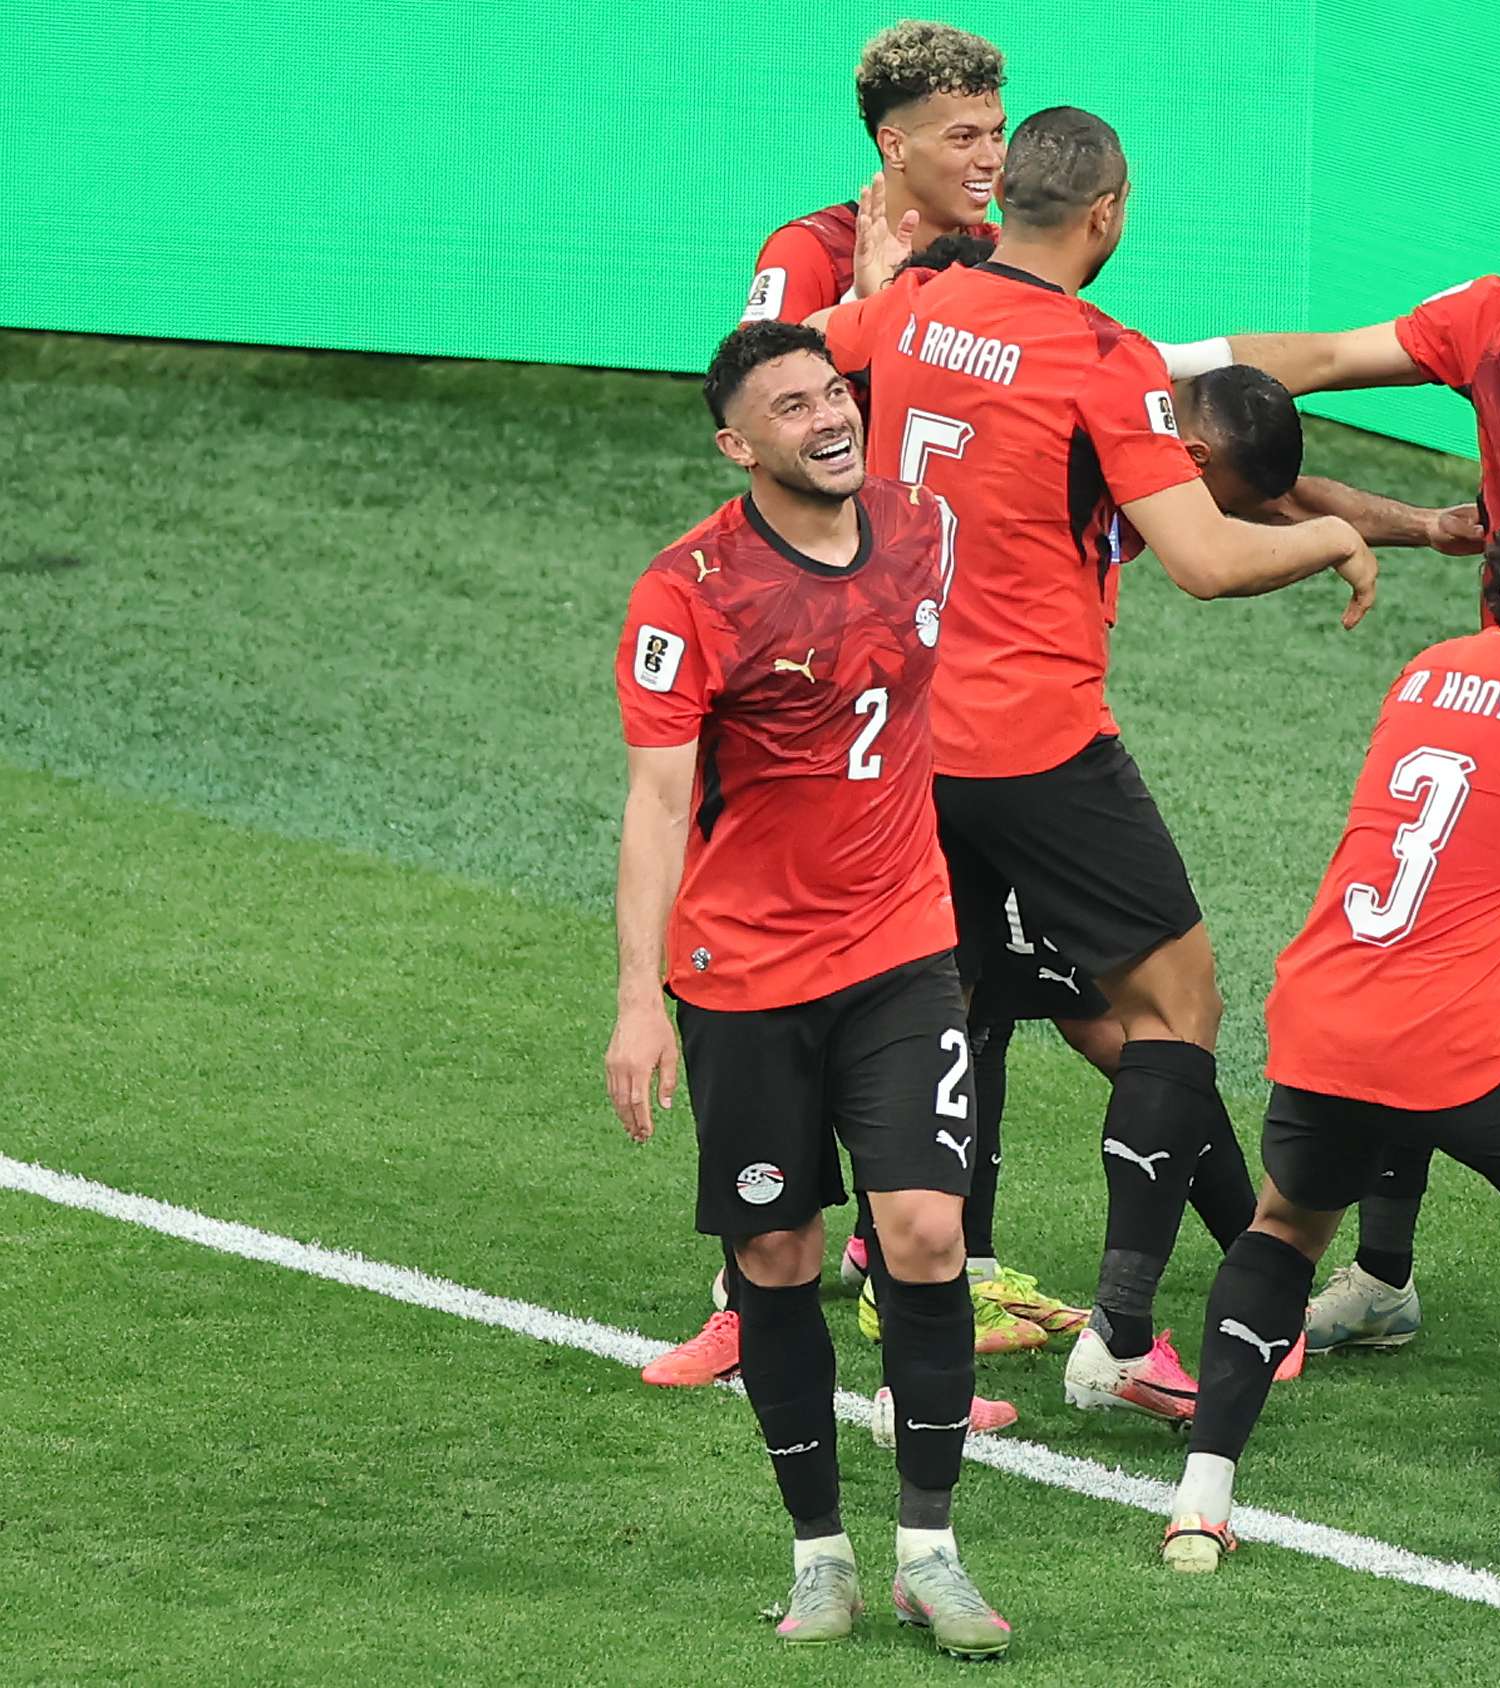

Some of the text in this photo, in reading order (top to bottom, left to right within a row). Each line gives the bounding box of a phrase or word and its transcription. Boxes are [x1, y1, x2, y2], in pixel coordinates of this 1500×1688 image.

[919, 321, 1021, 386] RABIAA
[1398, 670, 1423, 703] M.
[847, 686, 889, 780] 2
[1344, 745, 1478, 948] 3
[935, 1028, 969, 1120] 2
